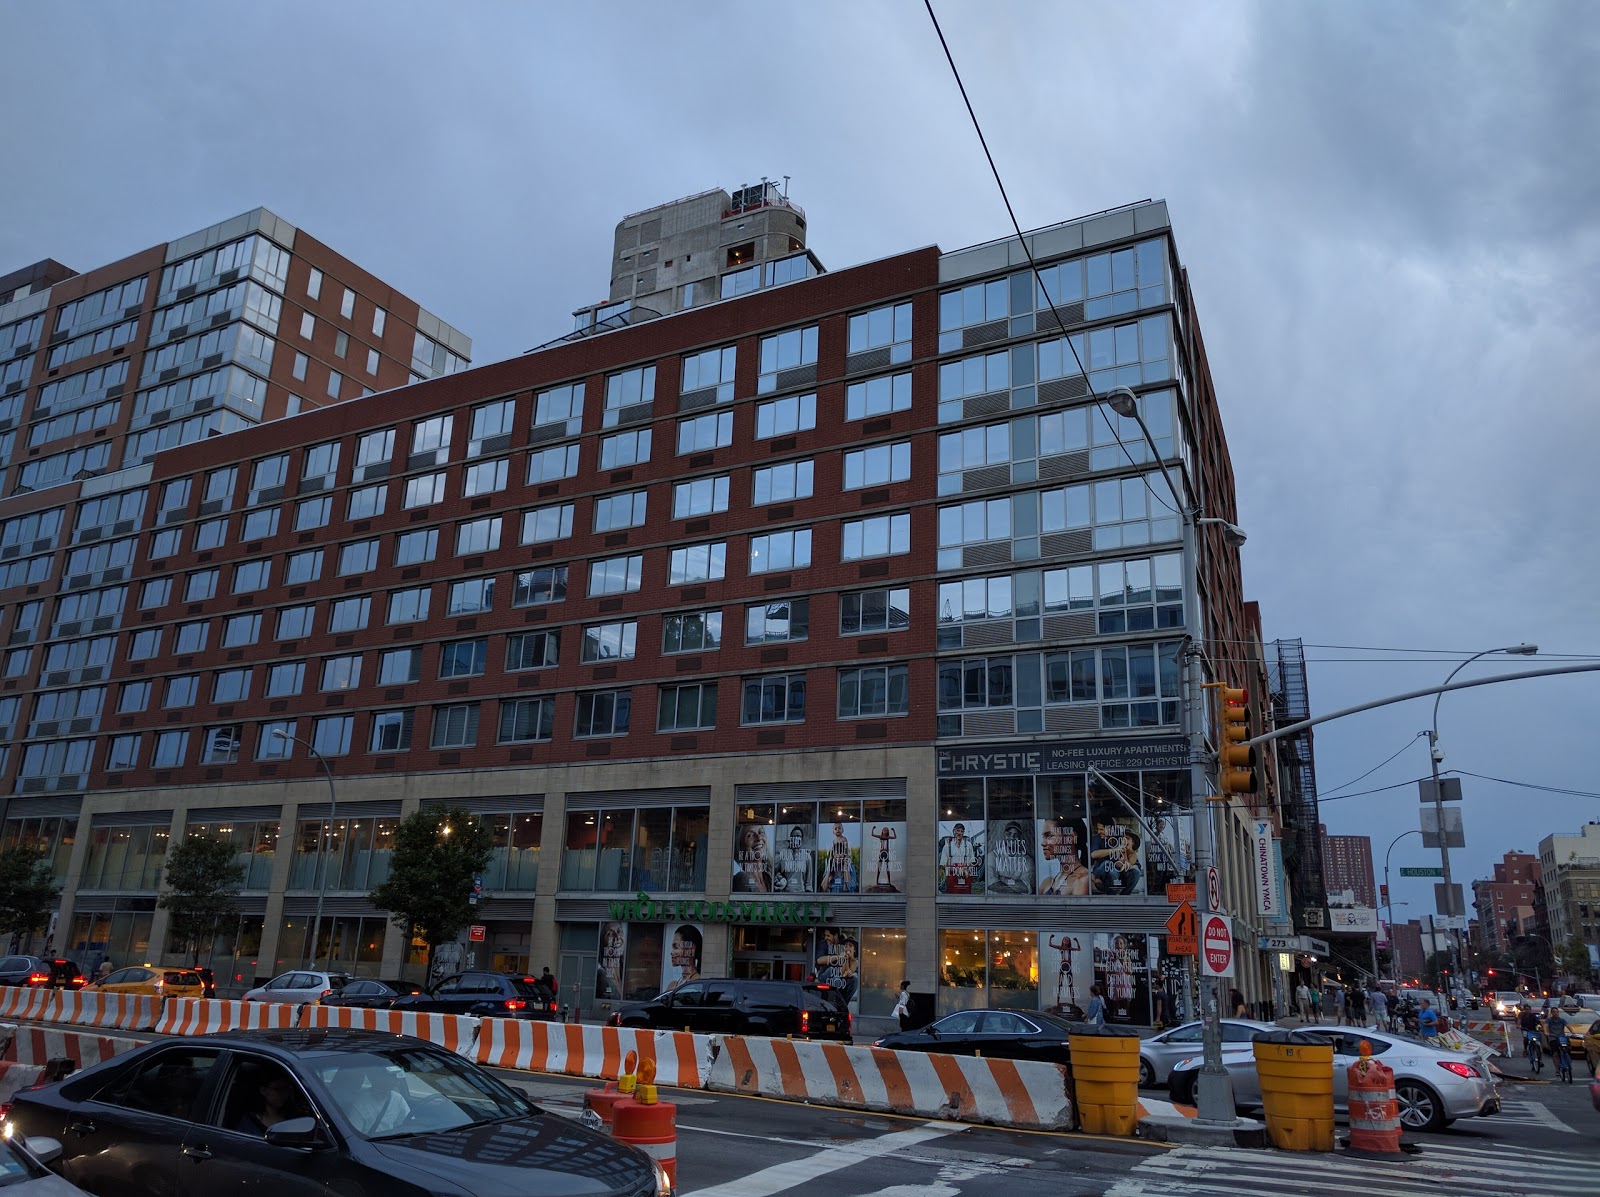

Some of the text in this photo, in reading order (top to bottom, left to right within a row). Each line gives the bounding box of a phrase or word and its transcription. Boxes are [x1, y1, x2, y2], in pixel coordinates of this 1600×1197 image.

[1052, 744, 1186, 758] NO-FEE LUXURY APARTMENTS
[938, 752, 1040, 772] CHRYSTIE
[1047, 760, 1085, 770] LEASING
[1088, 758, 1124, 768] OFFICE:
[1126, 758, 1142, 767] 229
[996, 840, 1026, 855] VALUES
[1104, 837, 1128, 848] FOOD
[996, 856, 1028, 872] MATTER
[1104, 860, 1130, 872] GOOD
[1258, 838, 1270, 911] CHINATOWN YMCA
[608, 899, 831, 924] WHOLE FOODS MARKET
[1208, 926, 1226, 937] DO NOT
[1210, 954, 1227, 964] ENTER
[1052, 961, 1080, 974] STRONG
[1106, 974, 1136, 986] DEFINITION
[1108, 986, 1137, 1001] OF YUMMY
